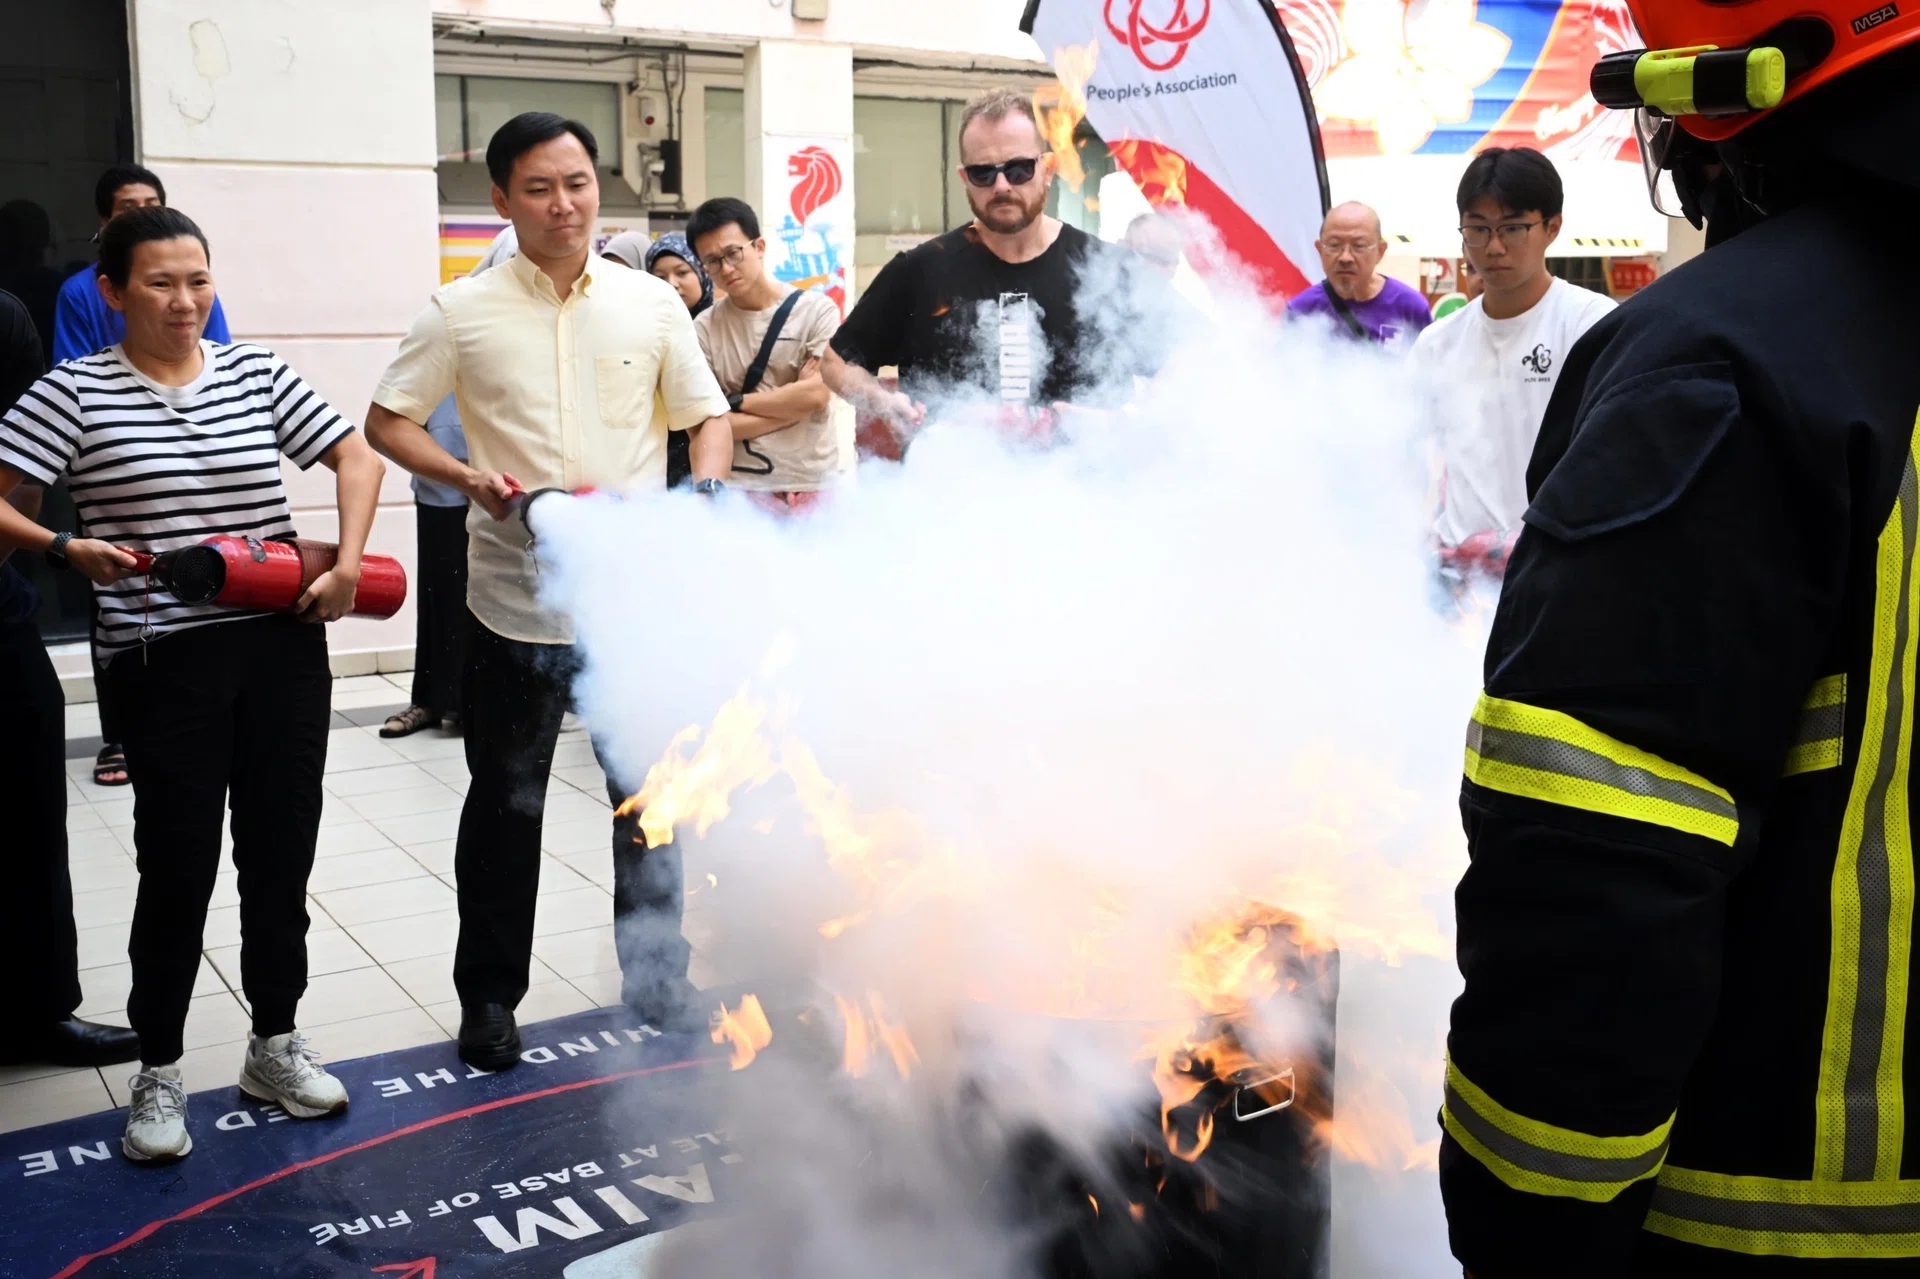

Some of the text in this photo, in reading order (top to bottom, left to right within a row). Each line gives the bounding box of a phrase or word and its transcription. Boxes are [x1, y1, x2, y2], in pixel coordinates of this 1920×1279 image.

[1854, 6, 1896, 32] MSA
[1086, 72, 1238, 103] People's Association
[520, 1023, 663, 1064] HIND
[215, 1104, 291, 1132] ED
[17, 1140, 113, 1178] NE
[618, 1143, 660, 1169] AT
[490, 1160, 605, 1200] BASE
[427, 1191, 481, 1218] OF
[472, 1161, 716, 1254] AIM
[308, 1209, 413, 1247] FIRE
